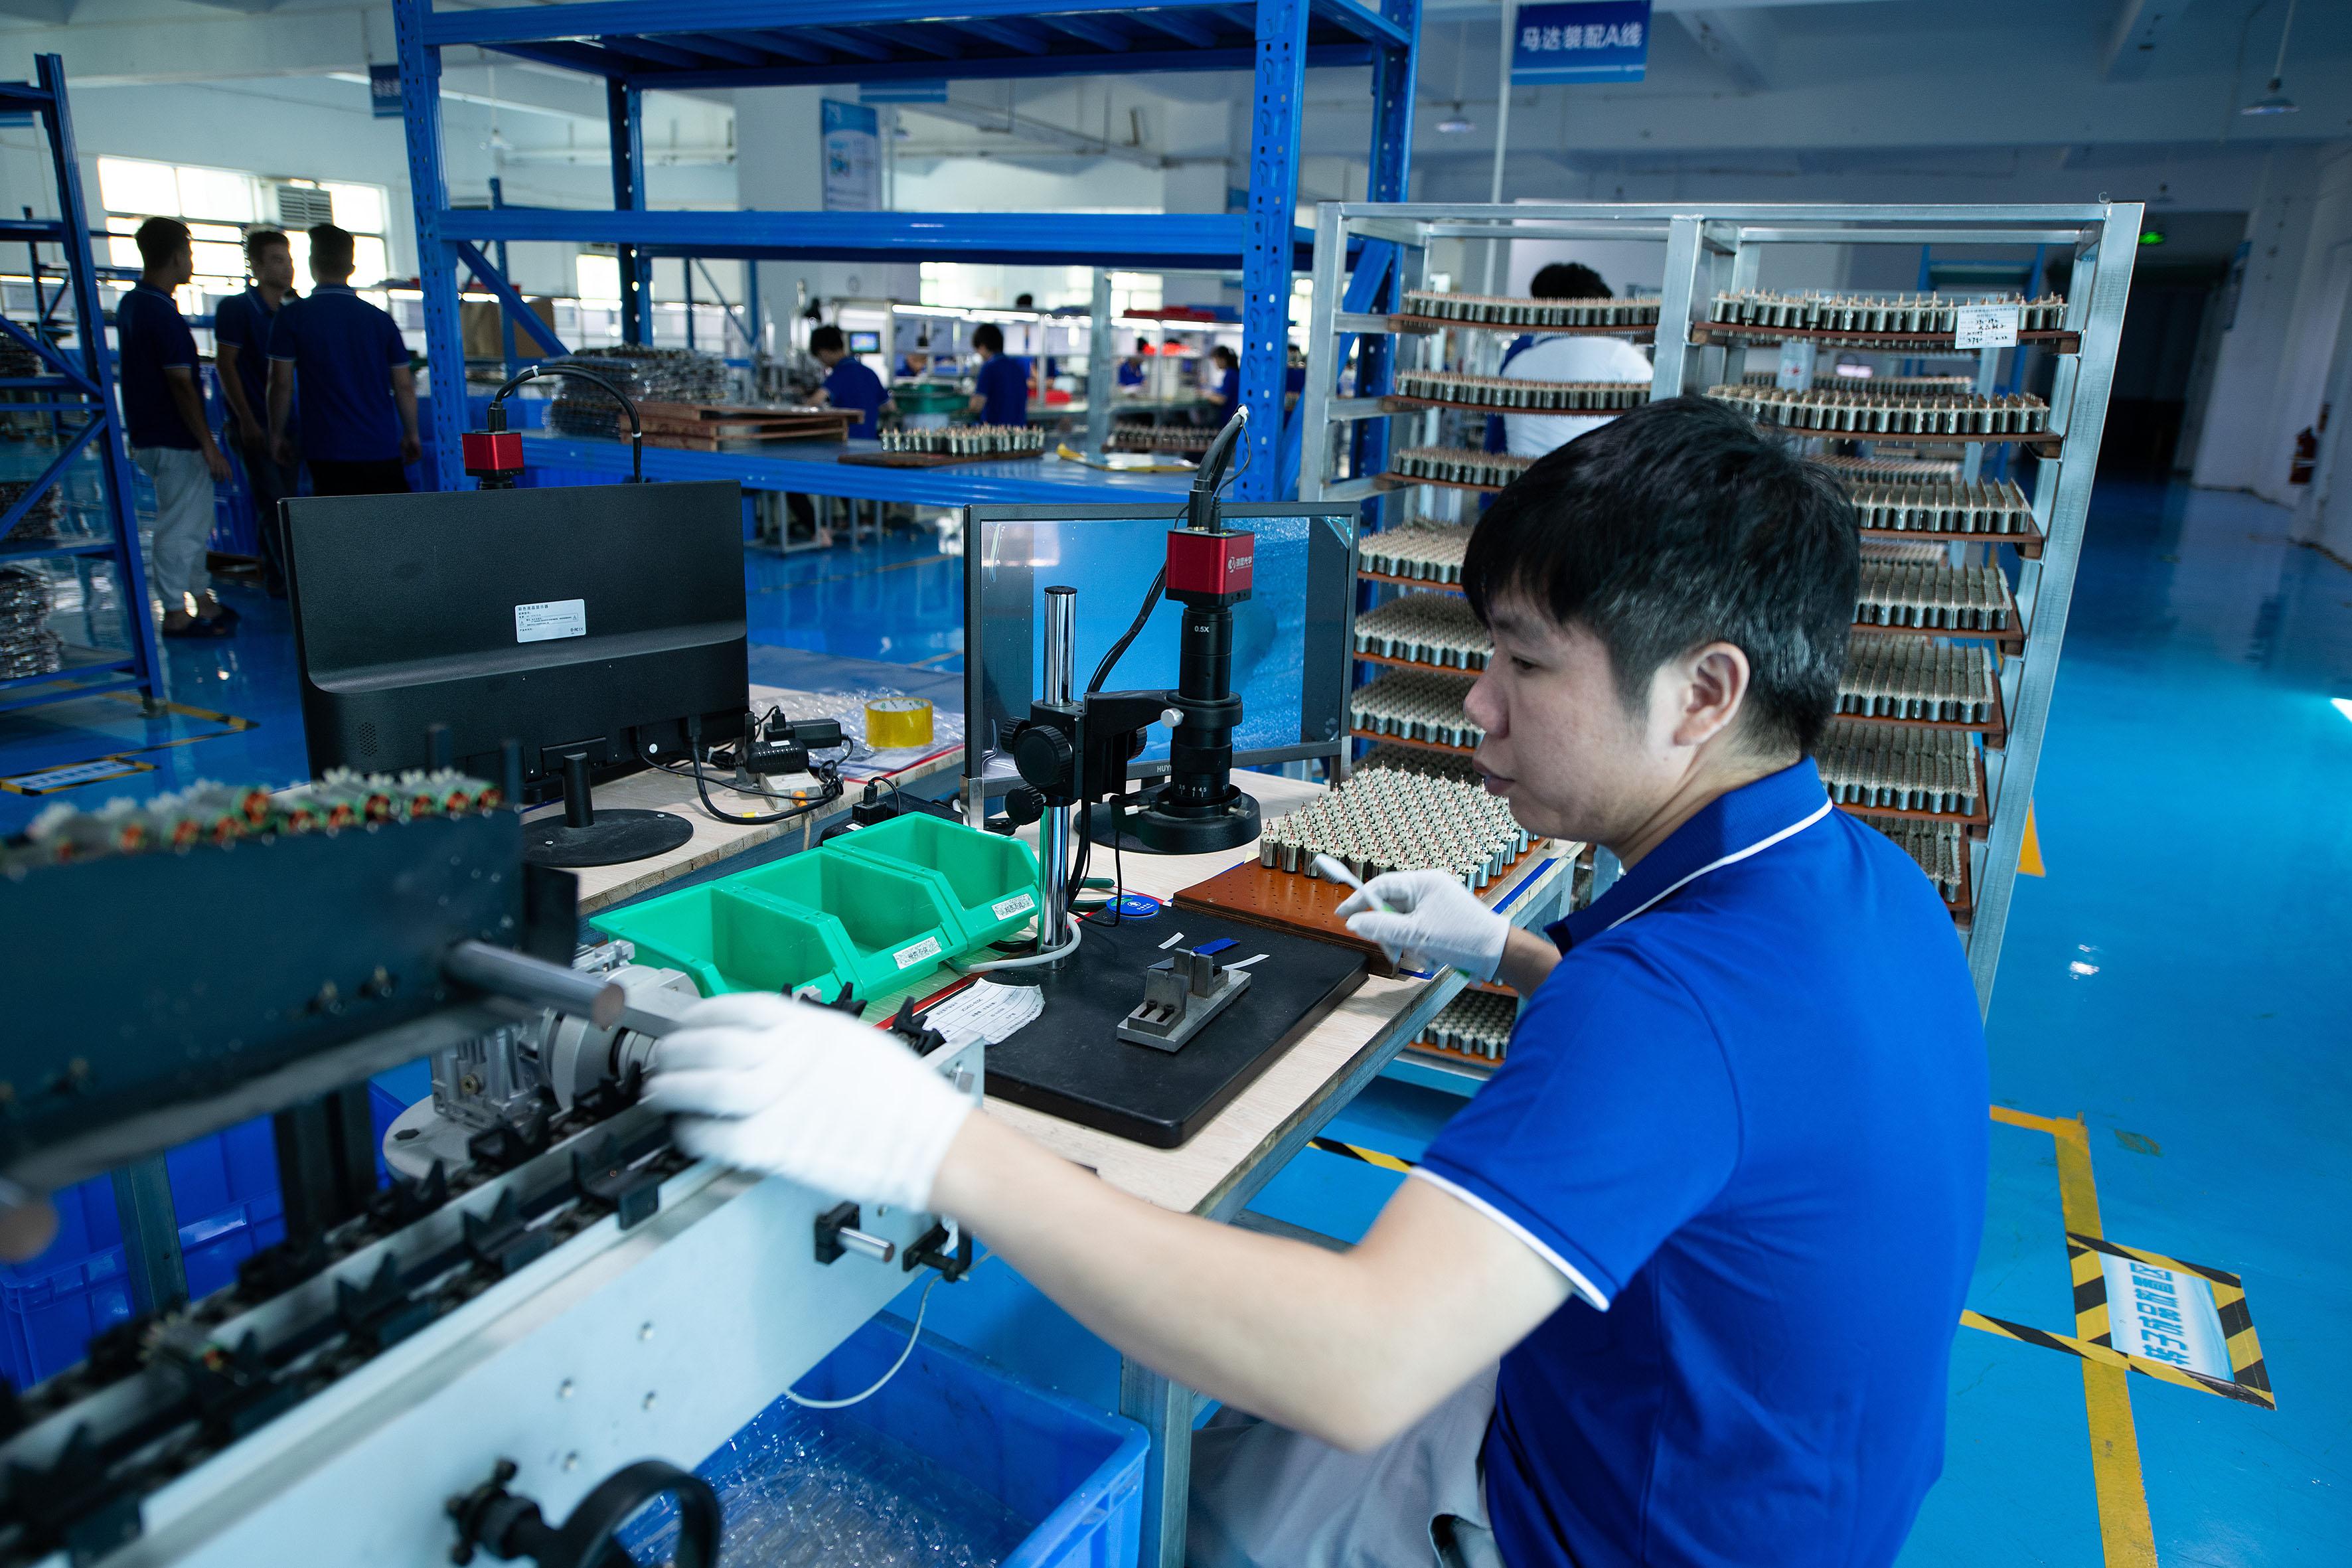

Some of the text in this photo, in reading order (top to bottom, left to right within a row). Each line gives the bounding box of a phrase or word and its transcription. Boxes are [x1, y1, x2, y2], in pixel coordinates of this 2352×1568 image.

[2129, 1261, 2192, 1366] 转子成品放置区
